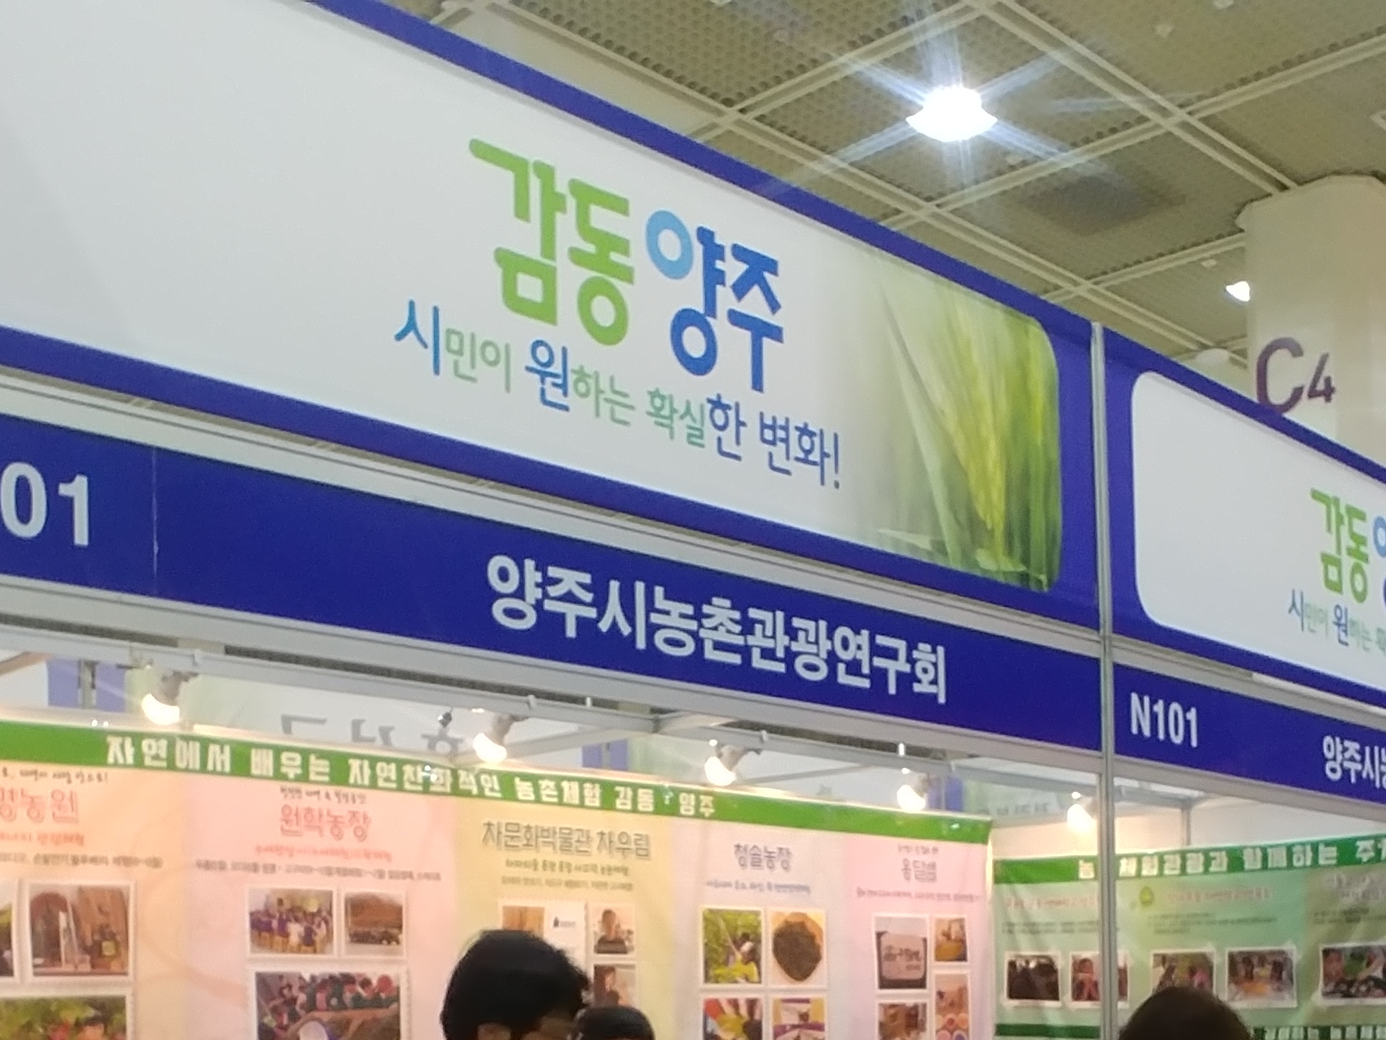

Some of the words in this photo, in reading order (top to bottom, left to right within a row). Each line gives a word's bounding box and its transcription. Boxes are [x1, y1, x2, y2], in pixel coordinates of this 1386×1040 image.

[469, 138, 635, 347] 감동
[644, 209, 783, 394] 양주
[394, 300, 511, 394] 시민이
[525, 338, 635, 428] 원하는
[646, 388, 748, 462] 확실한
[758, 411, 841, 490] 변화!
[1310, 488, 1370, 604] 감동
[485, 551, 948, 706] 양주시농촌관광연구회
[106, 735, 231, 774] 자연에서
[249, 748, 331, 784] 배우는
[1129, 691, 1199, 750] N101
